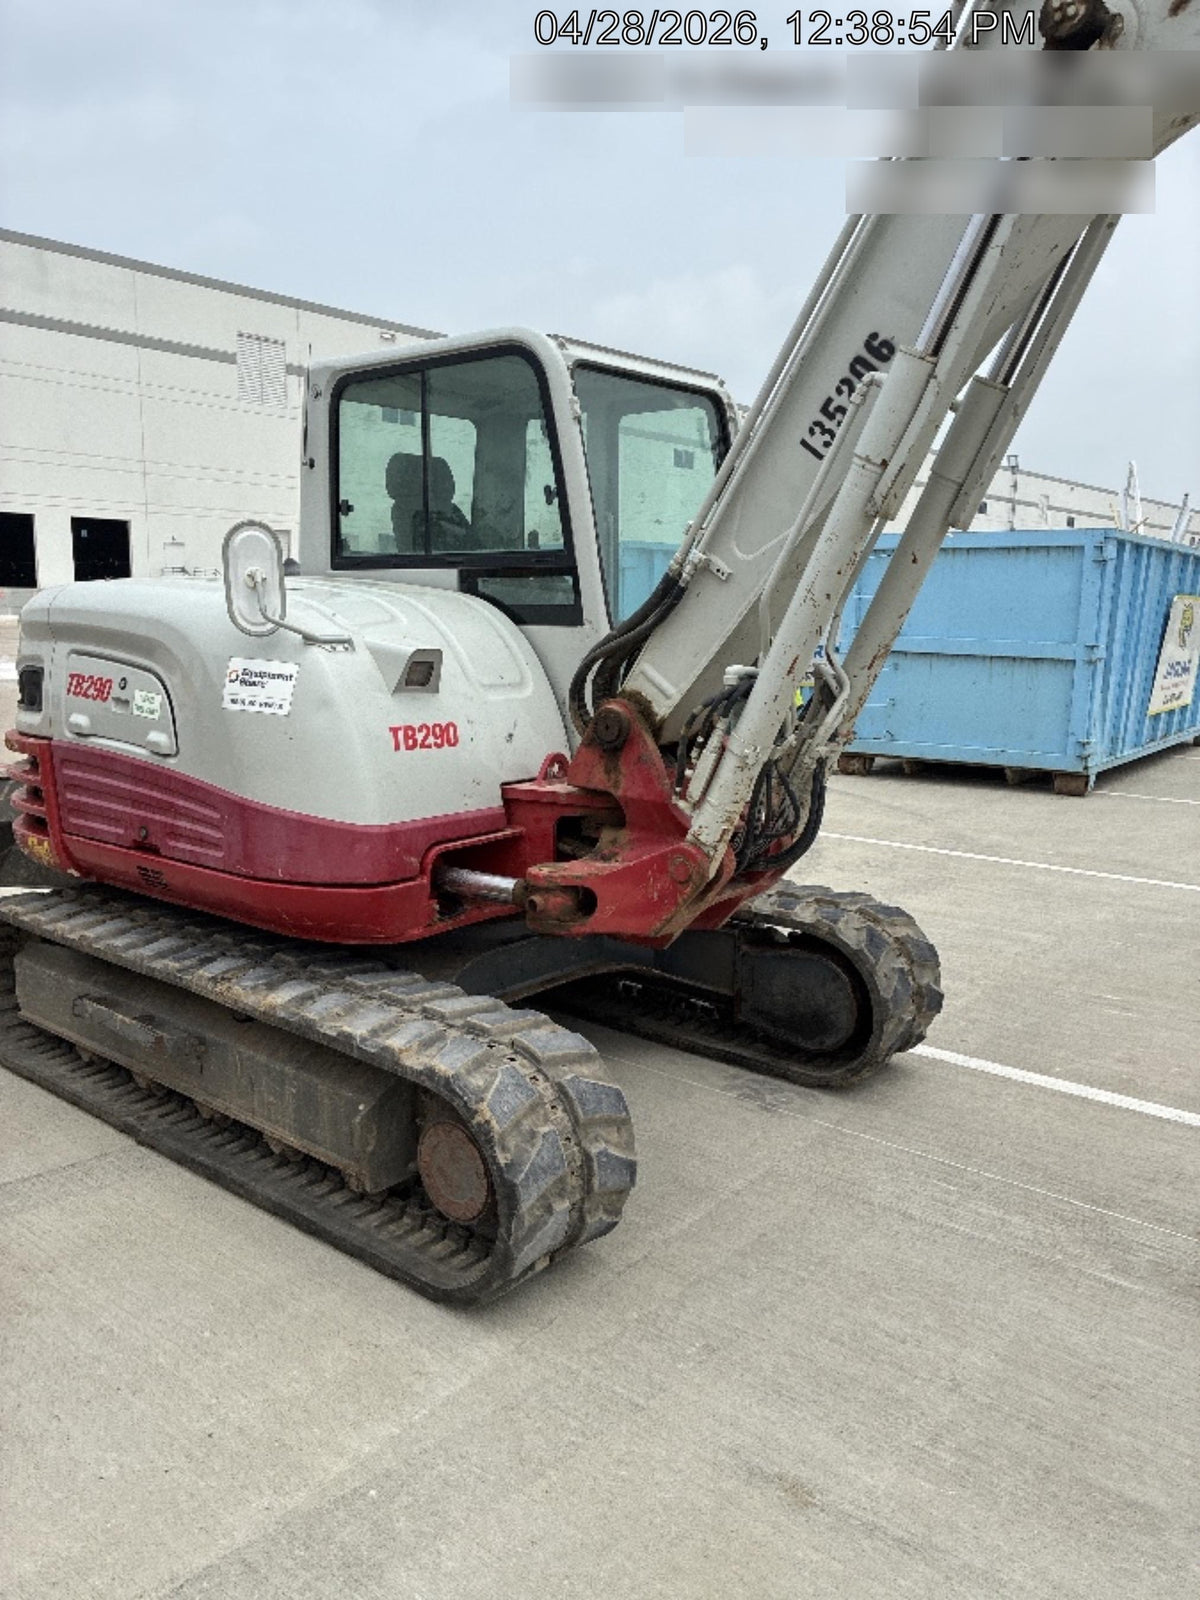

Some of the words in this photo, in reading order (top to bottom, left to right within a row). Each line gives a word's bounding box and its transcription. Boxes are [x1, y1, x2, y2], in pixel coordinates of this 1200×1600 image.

[800, 332, 895, 461] 135206
[66, 673, 113, 702] TB290
[388, 721, 459, 752] TB290
